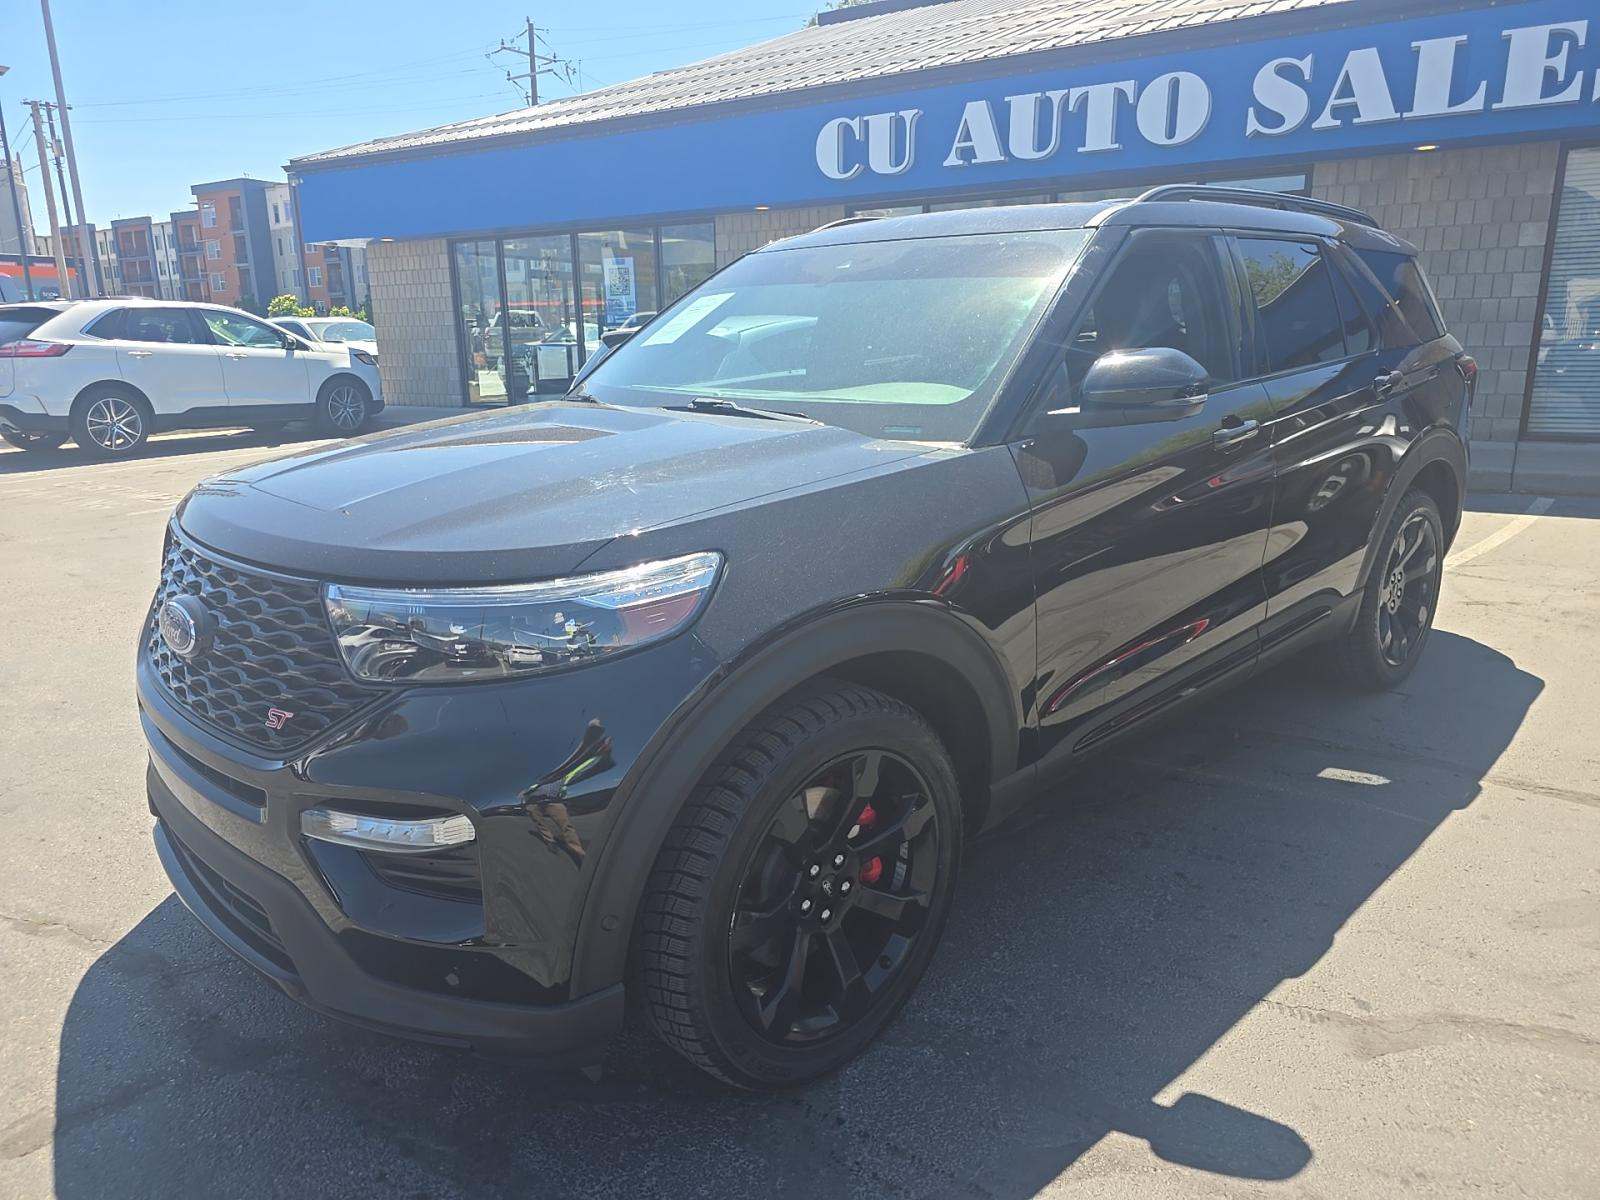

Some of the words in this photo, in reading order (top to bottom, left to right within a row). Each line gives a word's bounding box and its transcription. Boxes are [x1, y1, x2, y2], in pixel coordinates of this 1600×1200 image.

[816, 108, 923, 181] CU
[943, 71, 1212, 168] AUTO
[1246, 20, 1600, 137] SALE
[265, 708, 293, 729] ST
